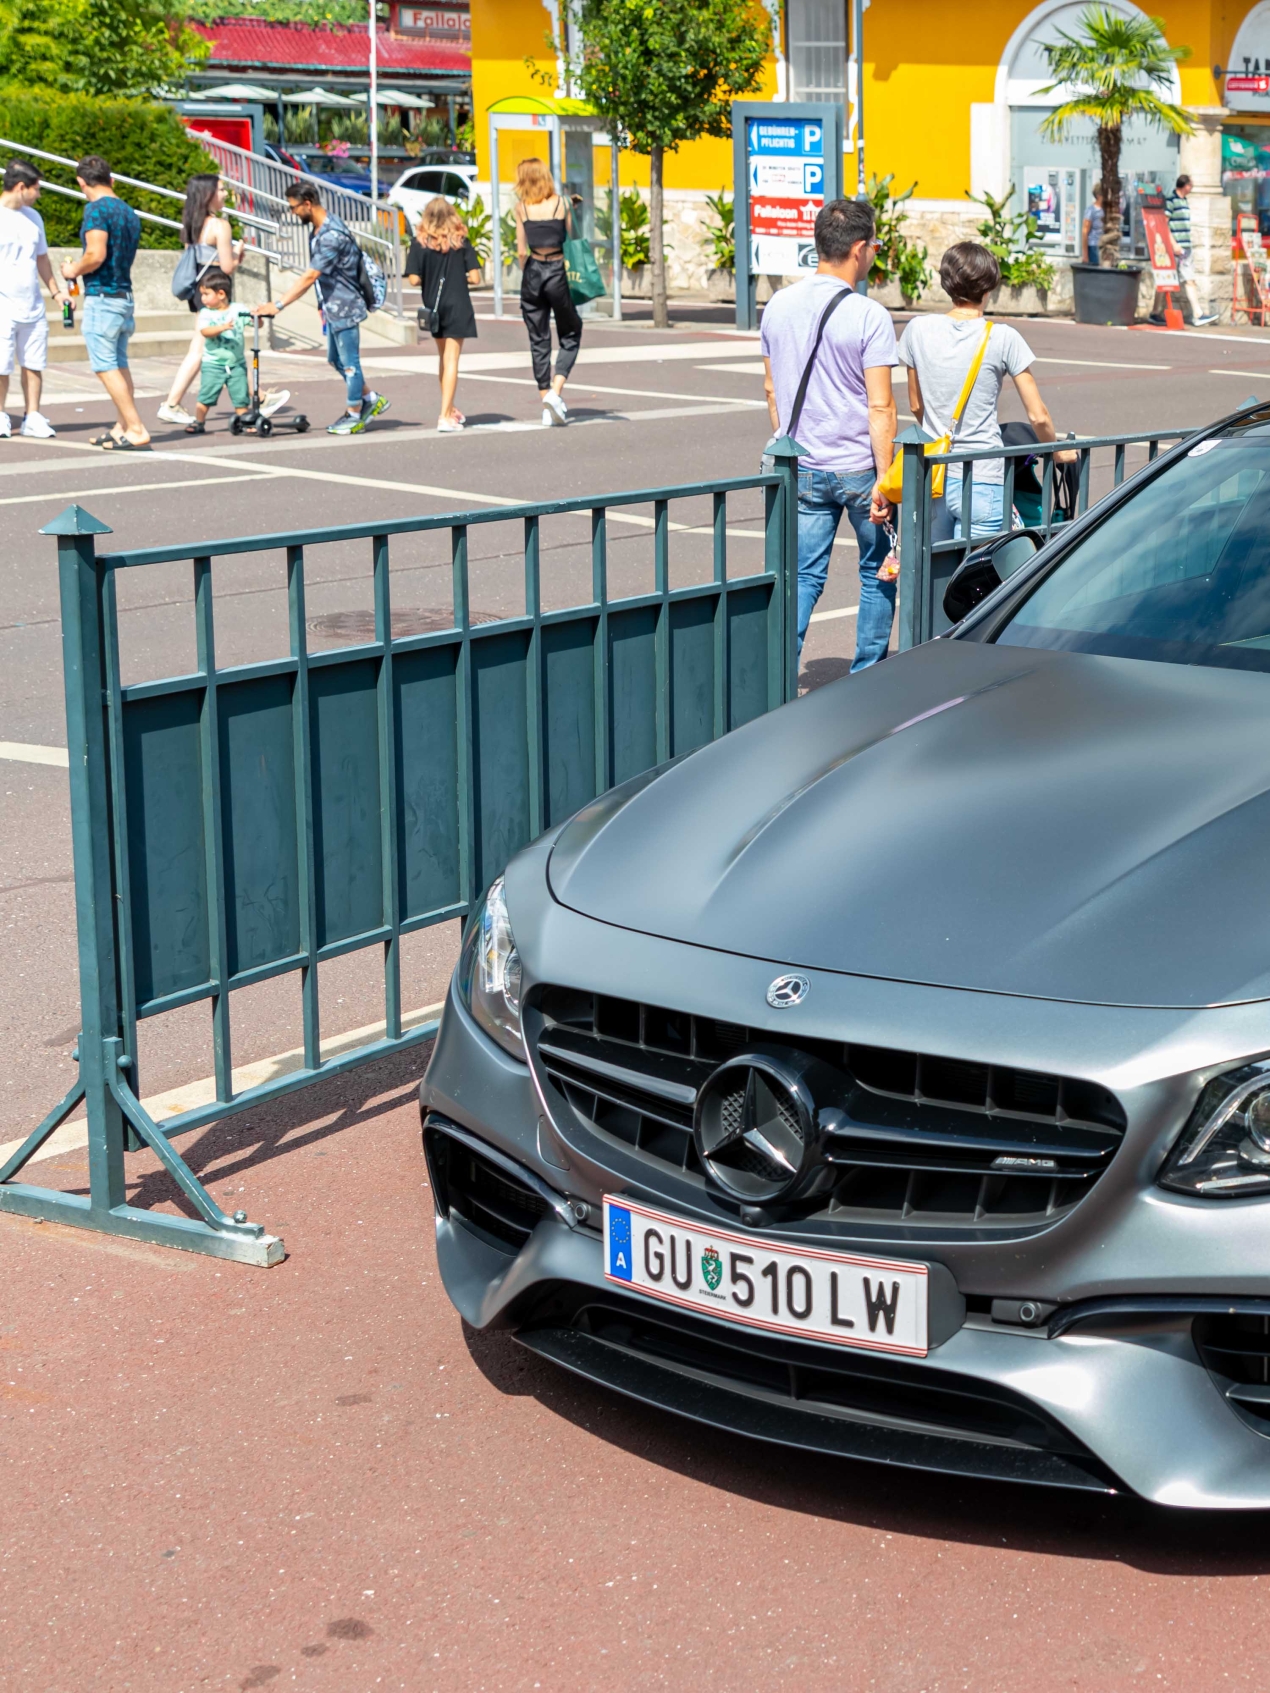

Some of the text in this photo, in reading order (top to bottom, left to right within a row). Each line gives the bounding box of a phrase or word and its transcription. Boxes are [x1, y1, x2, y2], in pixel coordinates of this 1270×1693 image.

[804, 124, 822, 152] P
[805, 165, 822, 193] P
[1014, 1158, 1055, 1168] AMG
[615, 1252, 628, 1270] A
[643, 1228, 901, 1335] GU 510 LW
[699, 1288, 727, 1301] STEIERMARK
